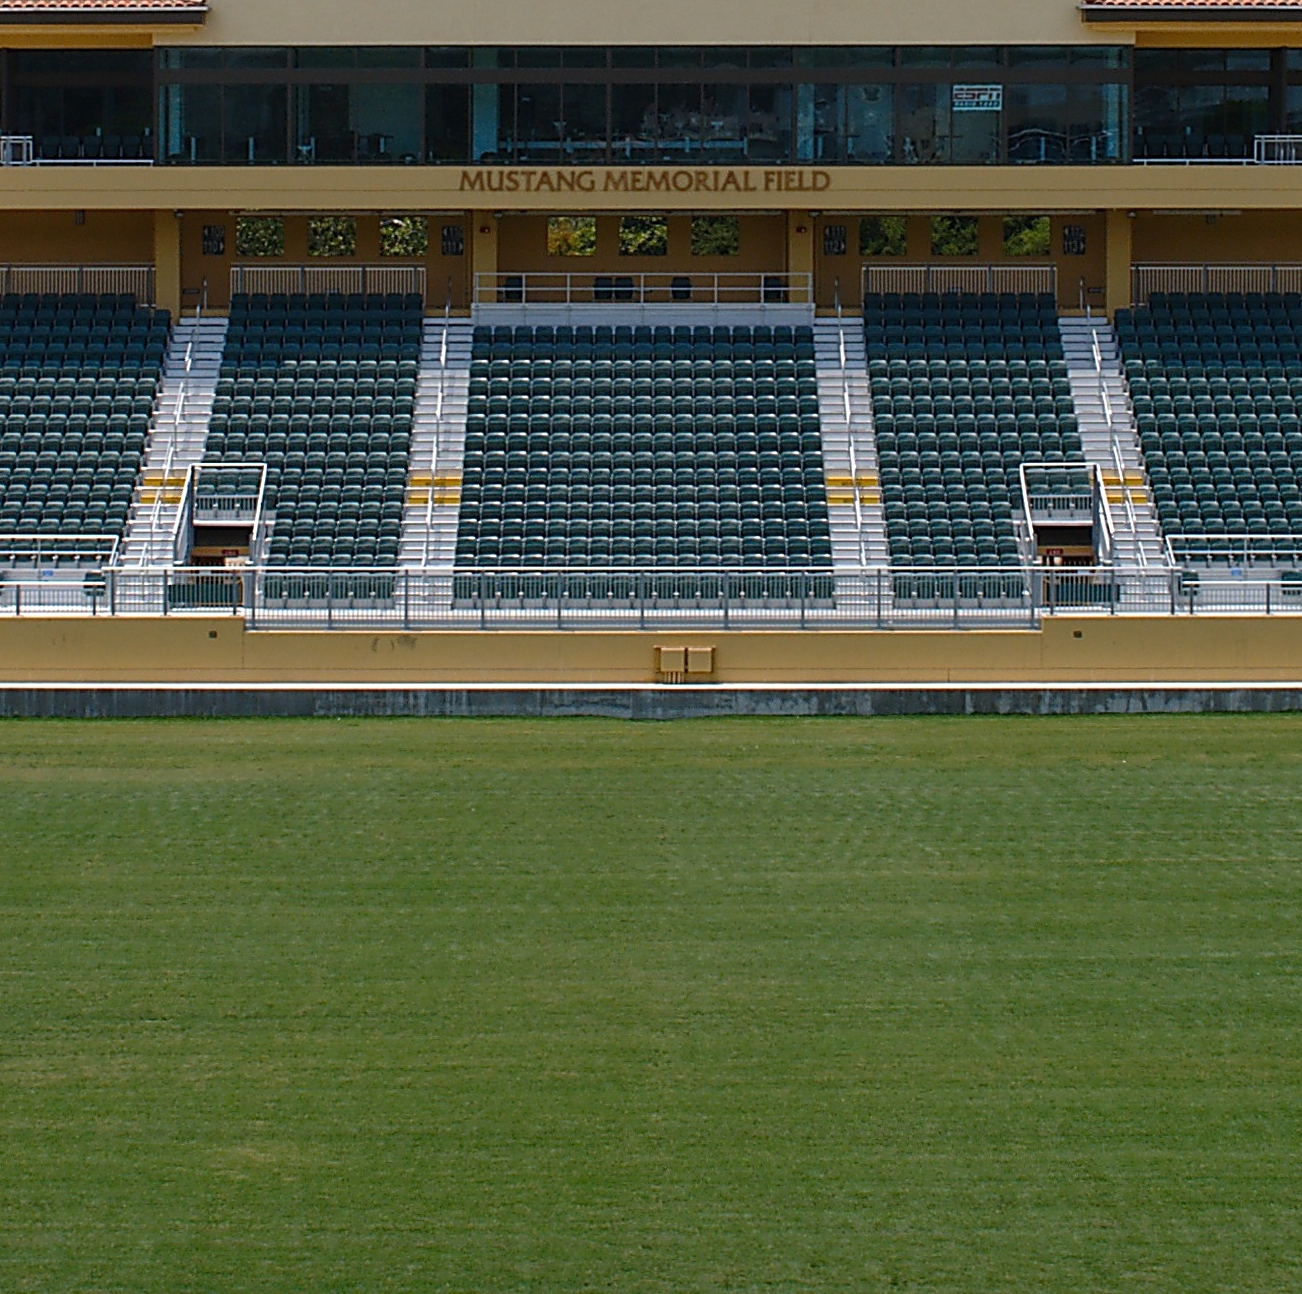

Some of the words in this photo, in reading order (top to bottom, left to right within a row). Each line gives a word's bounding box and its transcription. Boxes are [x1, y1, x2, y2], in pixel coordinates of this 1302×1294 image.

[953, 87, 1002, 101] ESPN
[458, 170, 596, 193] MUSTANG
[602, 170, 757, 193] MEMORIAL
[763, 170, 831, 193] FIELD
